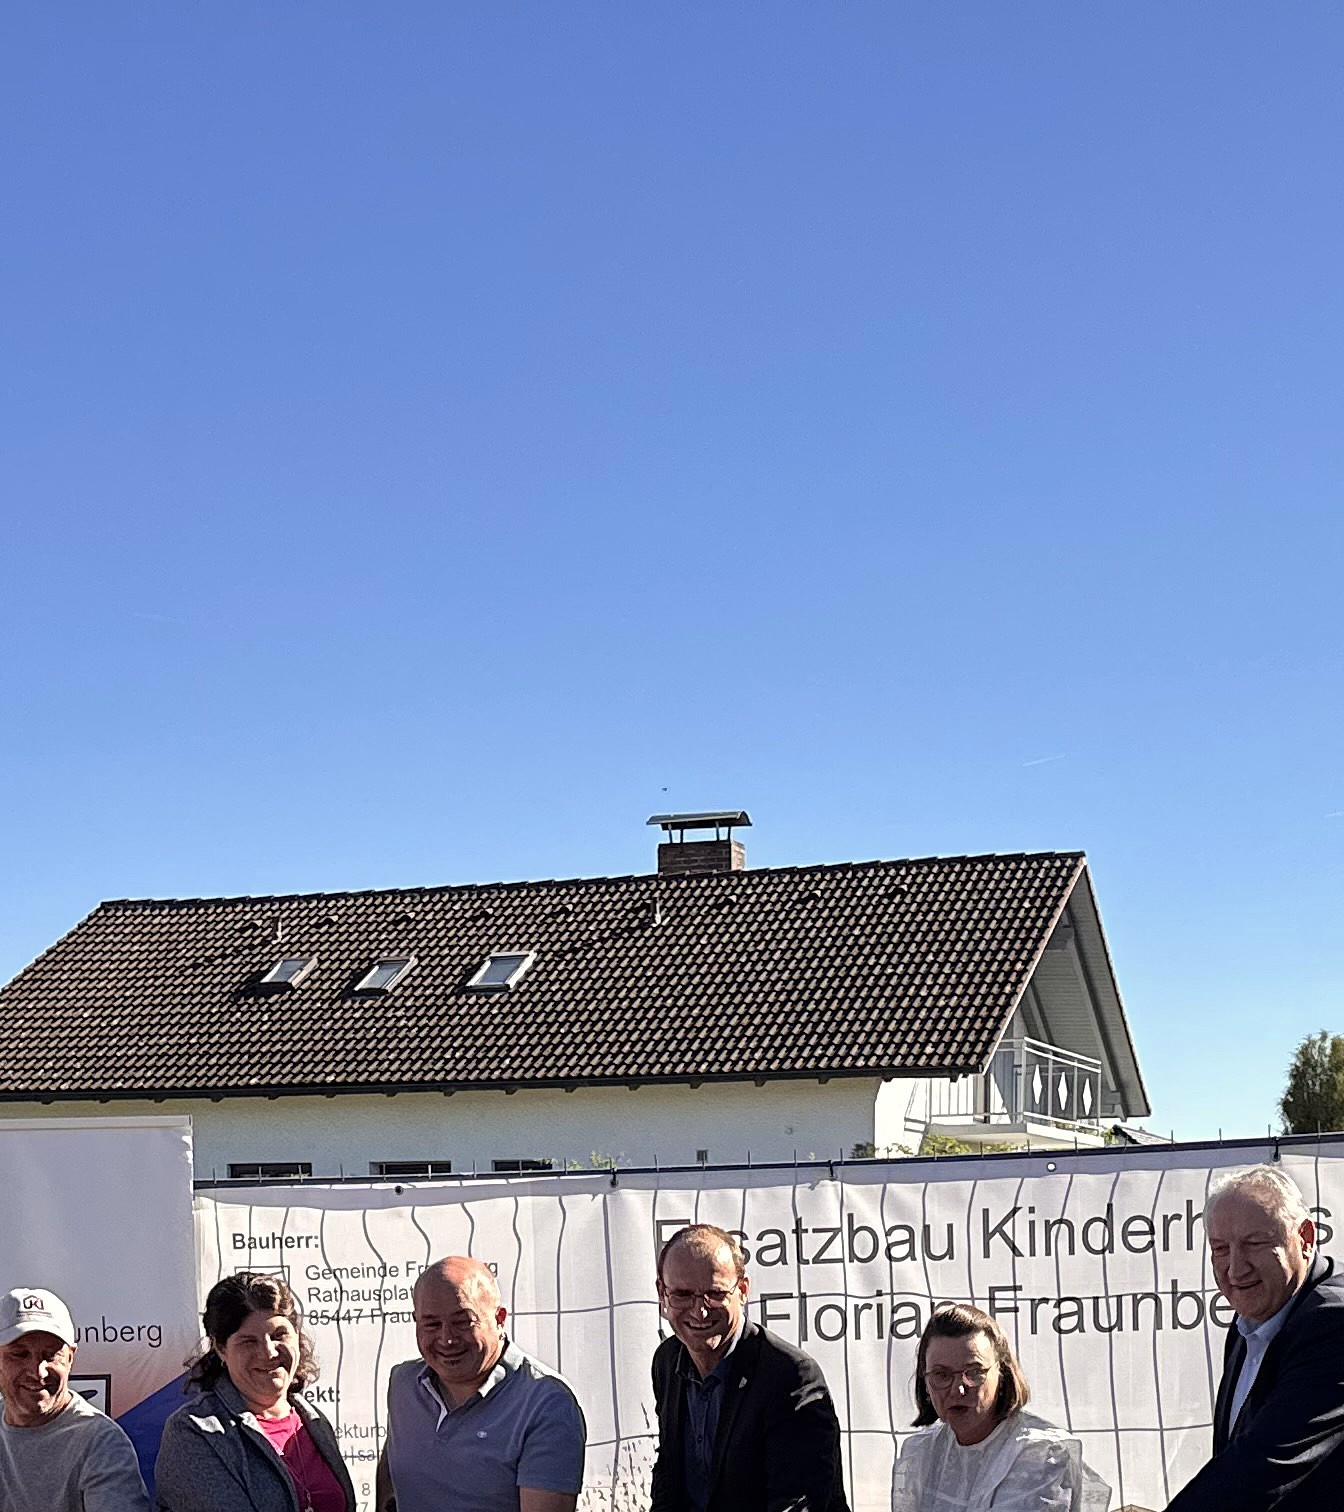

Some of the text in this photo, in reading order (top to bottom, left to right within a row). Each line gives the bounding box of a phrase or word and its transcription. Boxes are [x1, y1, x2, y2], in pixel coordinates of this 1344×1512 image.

[232, 1232, 319, 1251] Bauherr:
[656, 1199, 1334, 1267] Esatzbau Kinderhs
[305, 1262, 399, 1281] Gemeinde
[307, 1284, 415, 1306] Rathausplat
[308, 1308, 364, 1326] 85447
[988, 1279, 1236, 1336] Fraunbe
